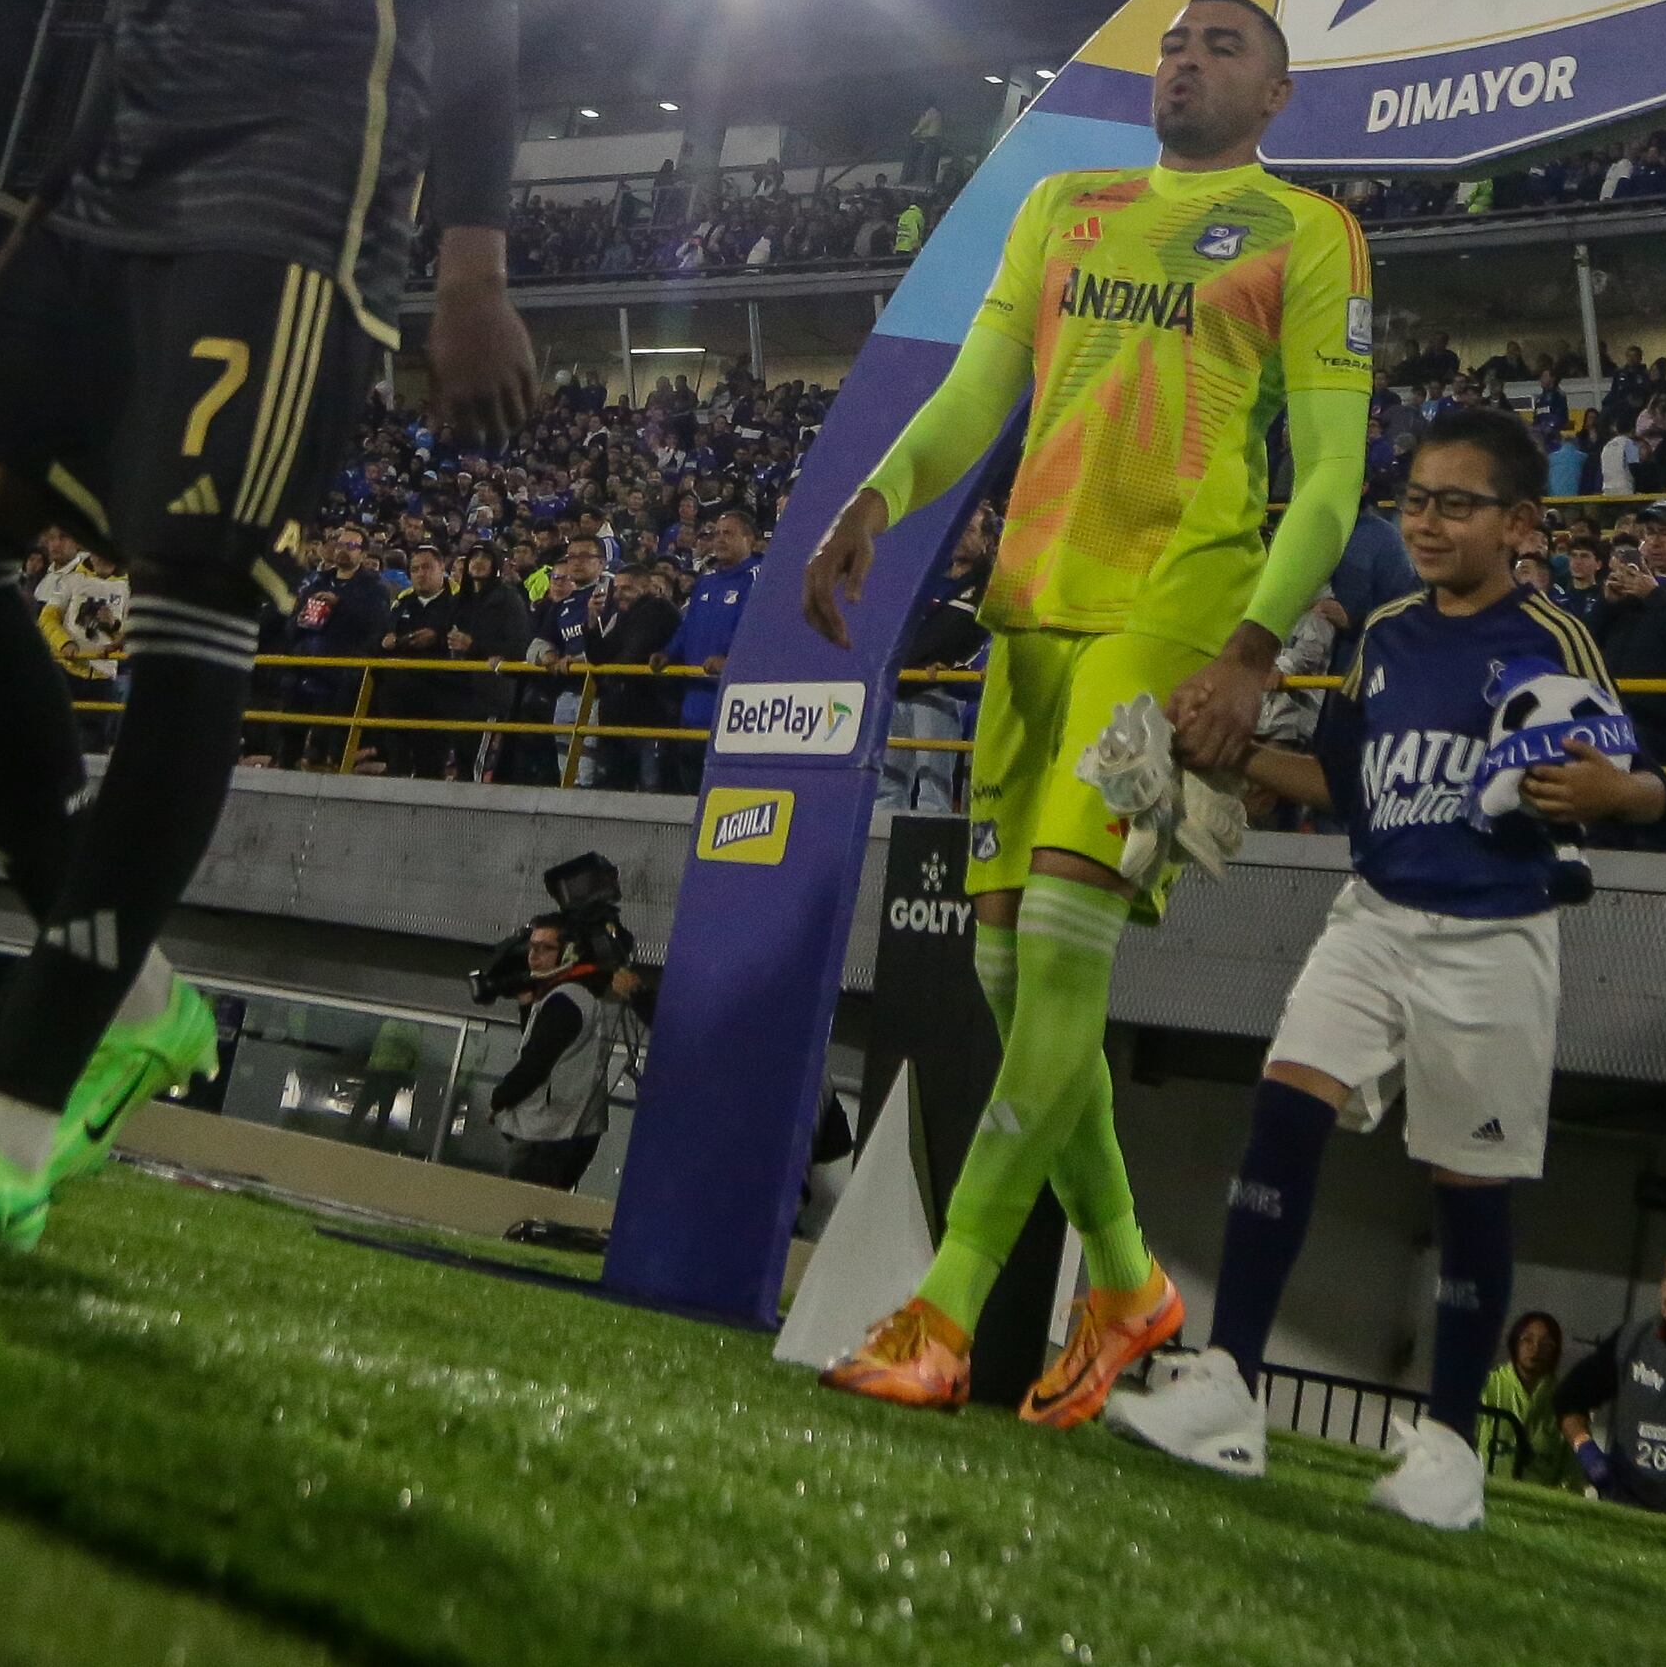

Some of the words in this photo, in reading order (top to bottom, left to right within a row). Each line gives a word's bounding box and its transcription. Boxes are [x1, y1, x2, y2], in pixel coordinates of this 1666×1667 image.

[1367, 55, 1578, 134] DIMAYOR
[1058, 266, 1196, 336] ANDINA
[181, 336, 250, 457] 7
[726, 694, 823, 743] BetPlay
[715, 804, 773, 847] AGUILA
[890, 897, 973, 936] GOLTY
